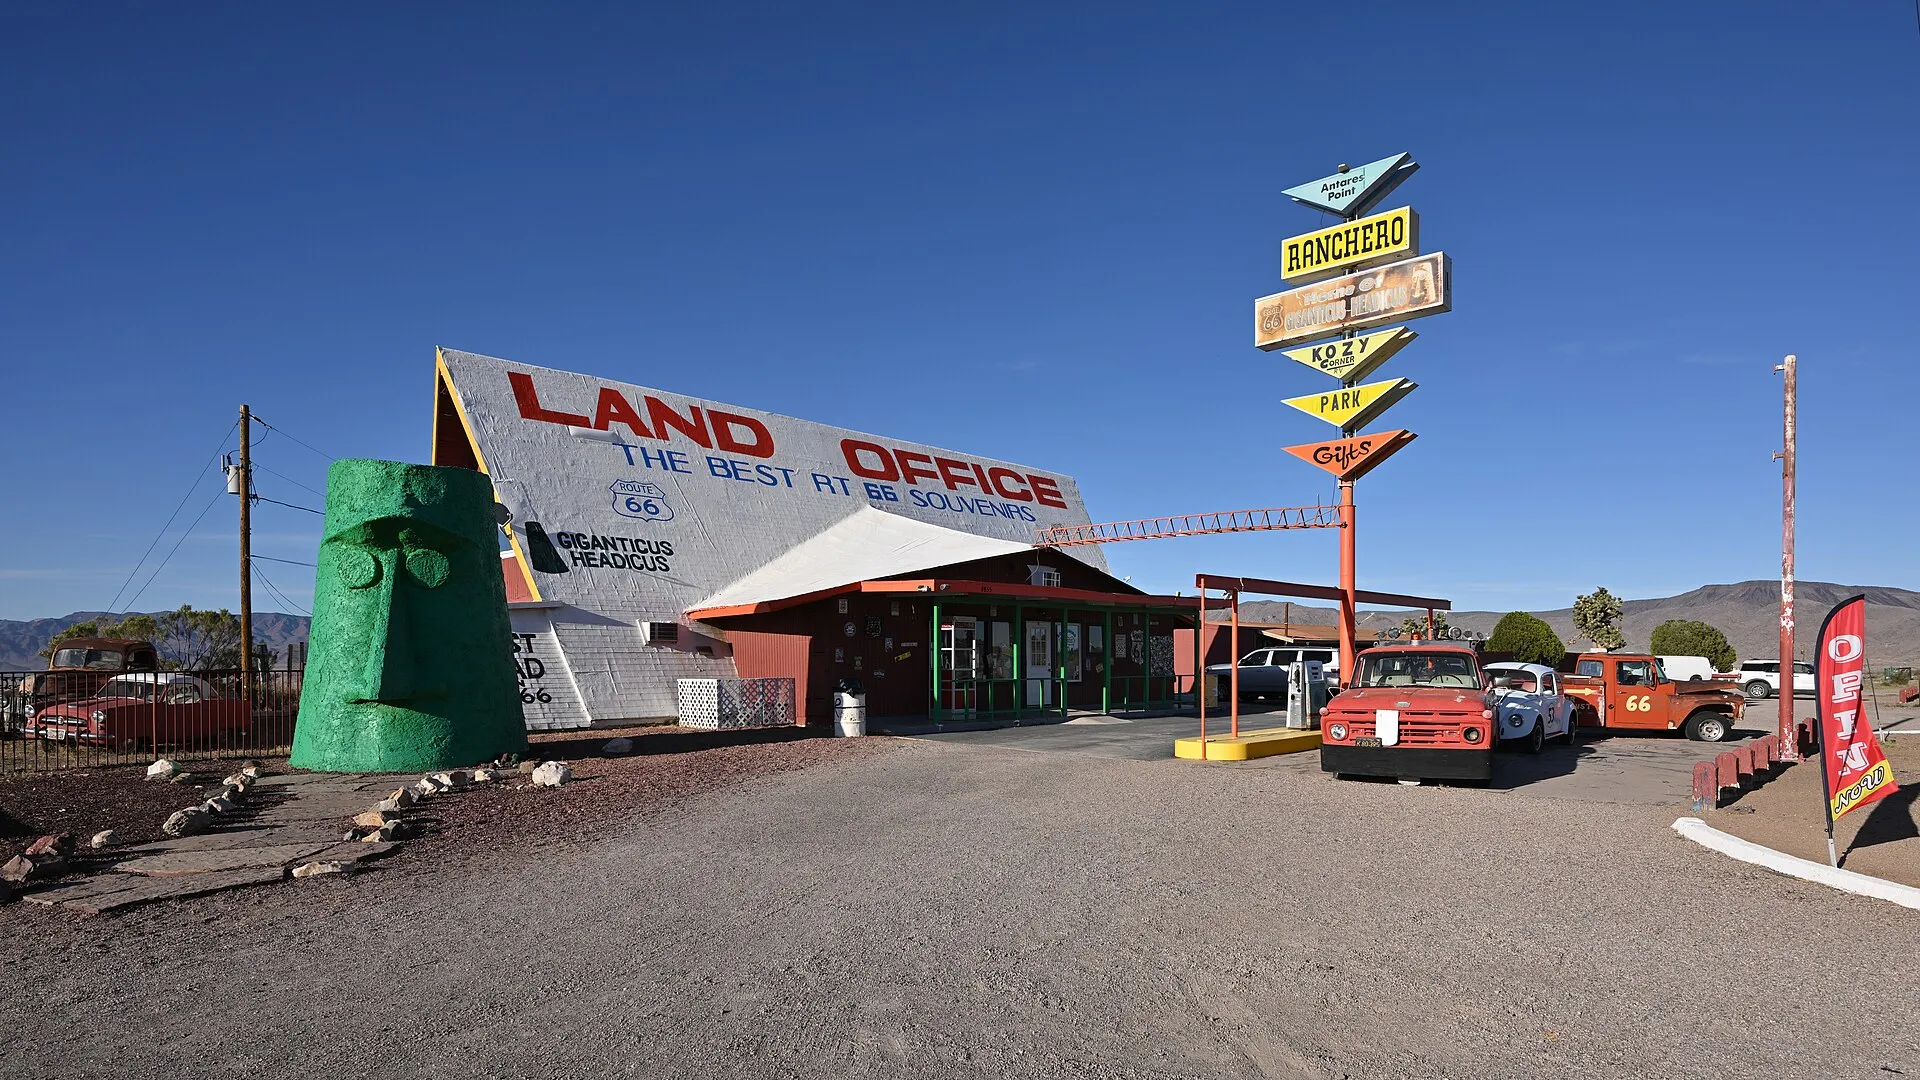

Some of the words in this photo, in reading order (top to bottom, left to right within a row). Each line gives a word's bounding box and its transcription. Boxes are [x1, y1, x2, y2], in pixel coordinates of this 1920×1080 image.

[1321, 173, 1365, 193] Antares
[1327, 186, 1356, 202] Point
[1287, 216, 1404, 272] RANCHERO
[1284, 300, 1347, 332] GIGANTICUS
[1350, 286, 1409, 317] HEADICUS
[1263, 314, 1281, 330] 66
[1312, 337, 1370, 363] KOZY
[1320, 356, 1355, 369] CORNER
[1320, 390, 1361, 413] PARK
[507, 371, 775, 459] LAND
[840, 438, 1068, 509] OFFICE
[1313, 441, 1372, 470] Gifts
[612, 443, 692, 475] THE
[706, 456, 794, 488] BEST
[811, 472, 850, 496] RT
[863, 482, 899, 502] 66
[909, 489, 1036, 522] SOUVENIRS
[619, 481, 654, 495] ROUTE
[625, 496, 660, 516] 66
[556, 531, 675, 557] GIGANTICUS
[570, 551, 670, 572] HEADICUS
[520, 688, 552, 704] 66
[1626, 695, 1651, 712] 66
[1828, 634, 1869, 776] OPEN
[1834, 766, 1884, 814] NOW
